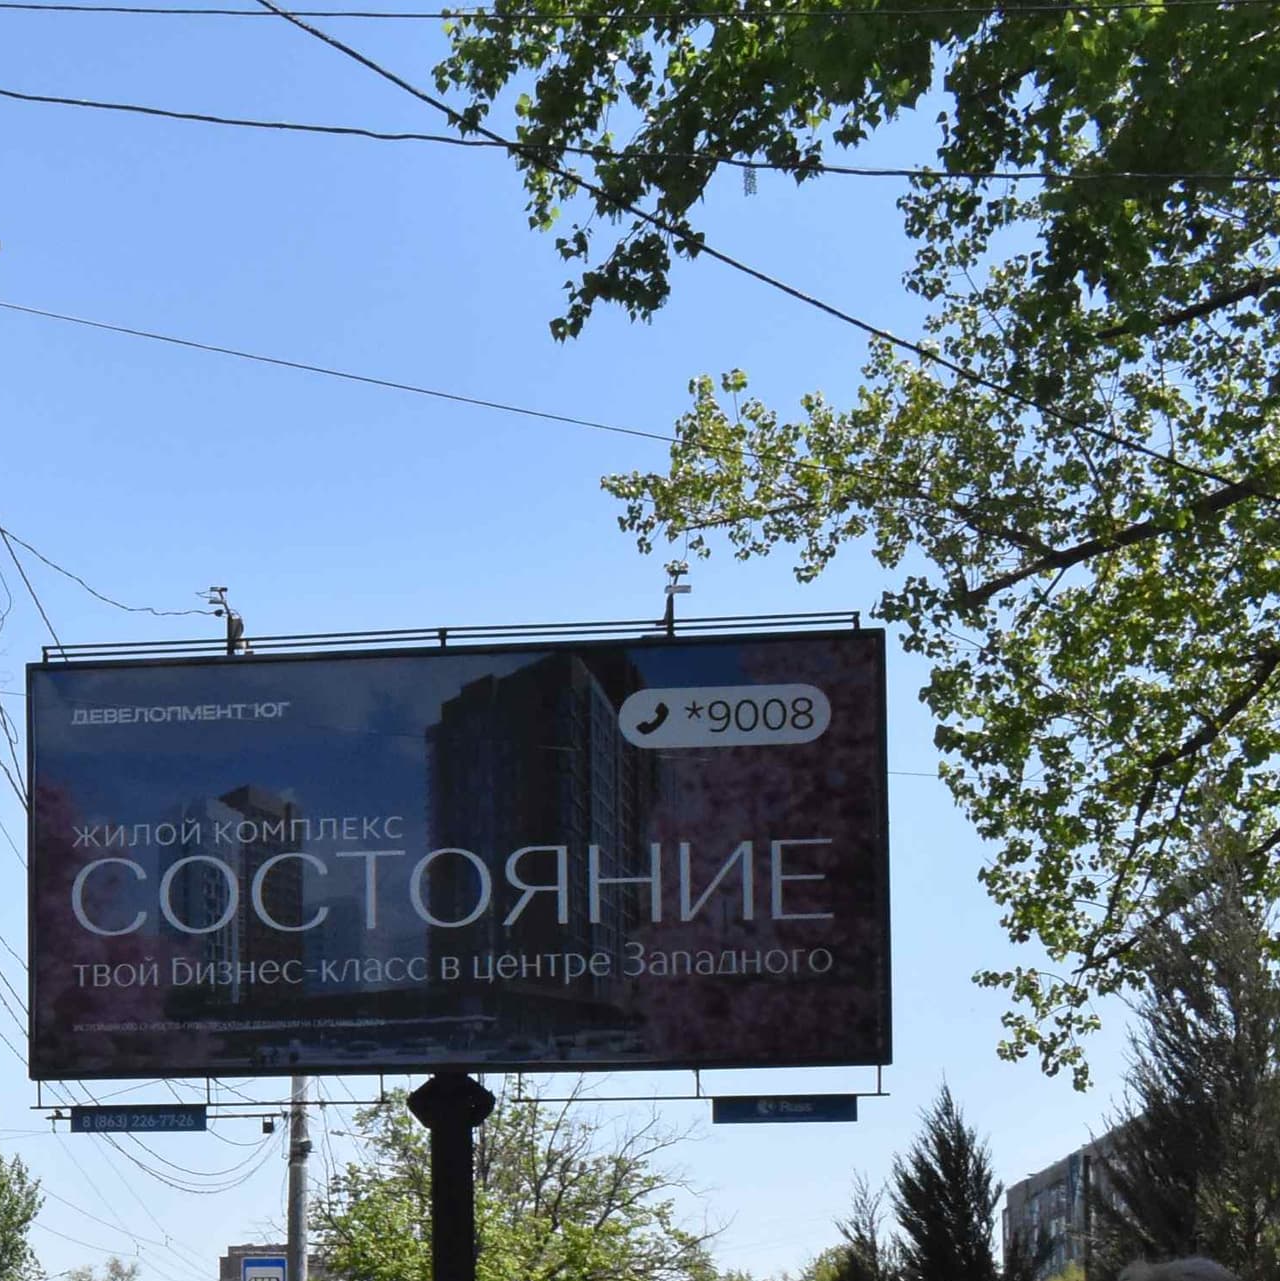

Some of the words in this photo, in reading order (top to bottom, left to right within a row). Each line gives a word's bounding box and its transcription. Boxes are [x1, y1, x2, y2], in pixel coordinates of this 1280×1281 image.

[71, 703, 247, 725] ДЕВЕЛОПМЕНТ
[254, 702, 290, 718] ЮГ
[71, 819, 201, 848] ЖИЛОЙ
[215, 815, 404, 844] КОМПЛЕКС
[71, 838, 835, 937] СОСТОЯНИЕ
[72, 956, 159, 988] твой
[441, 957, 460, 980] в
[473, 950, 611, 985] центре
[623, 941, 834, 977] Западного
[82, 1115, 92, 1128] 8
[94, 1114, 128, 1129] (863)
